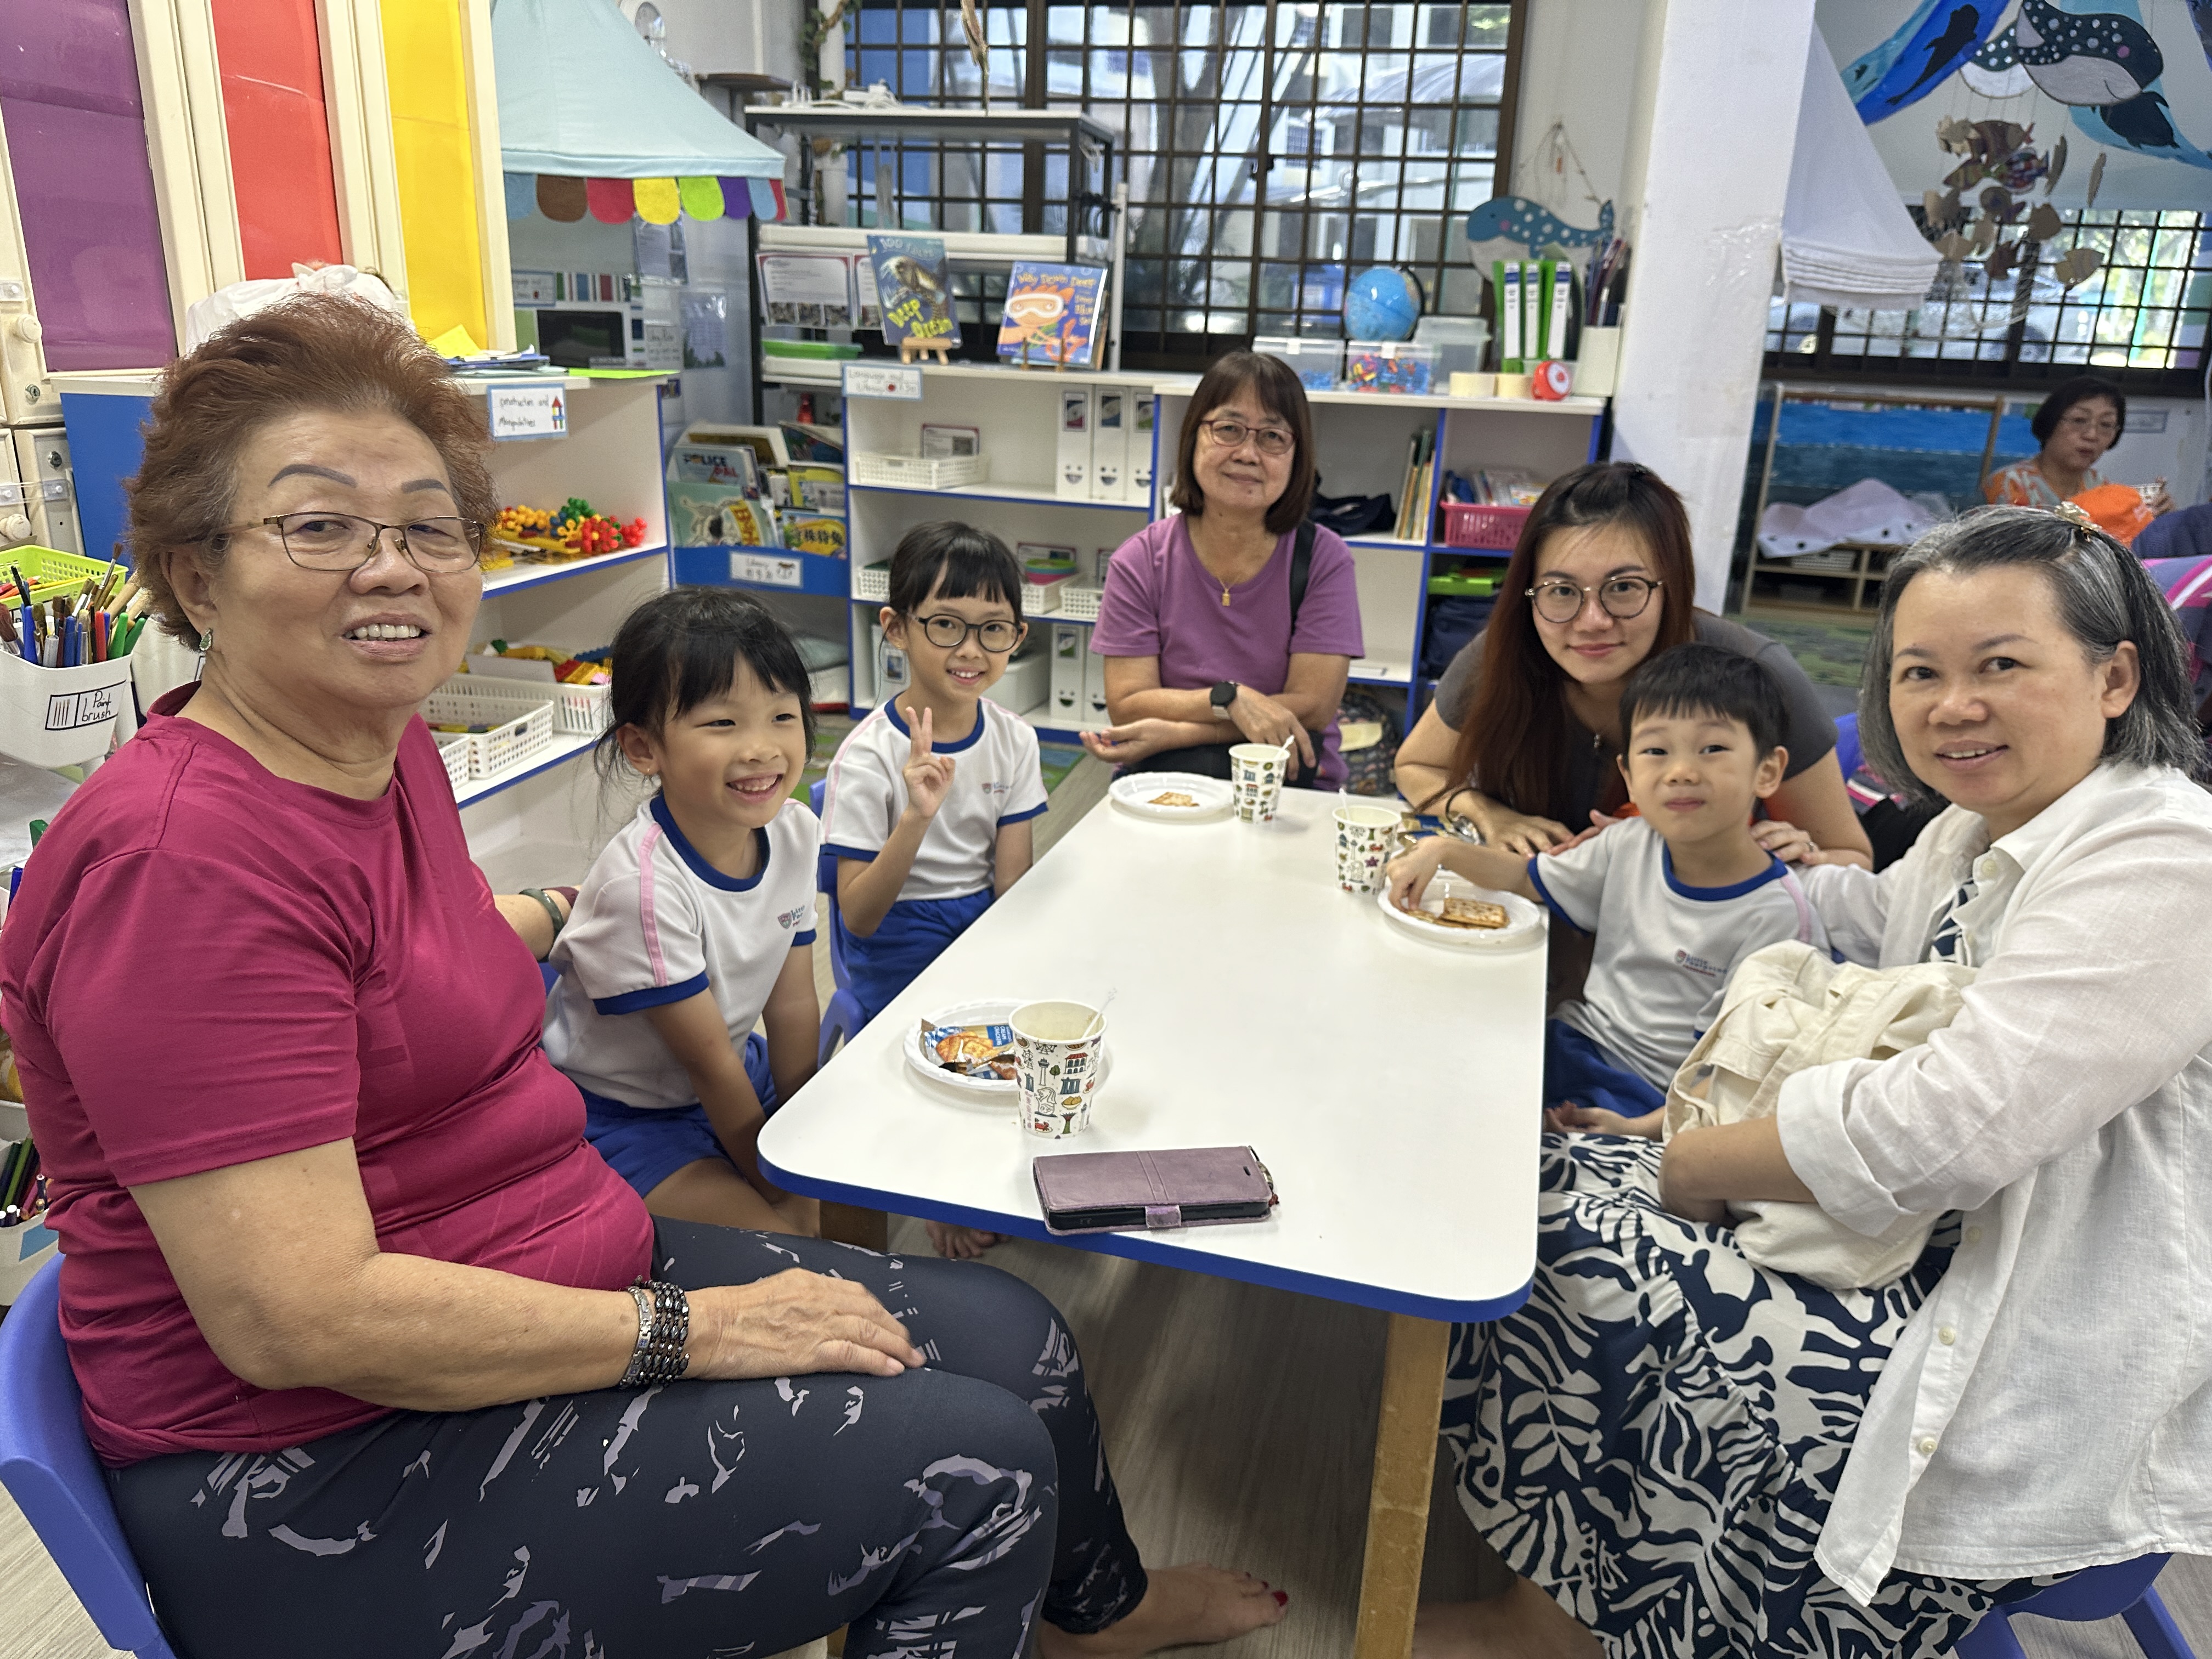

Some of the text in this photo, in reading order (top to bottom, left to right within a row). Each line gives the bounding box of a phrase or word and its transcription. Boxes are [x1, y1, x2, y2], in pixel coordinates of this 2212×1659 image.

[82, 697, 111, 721] brush
[93, 690, 112, 708] Paint
[994, 1025, 1002, 1046] CRACKERS
